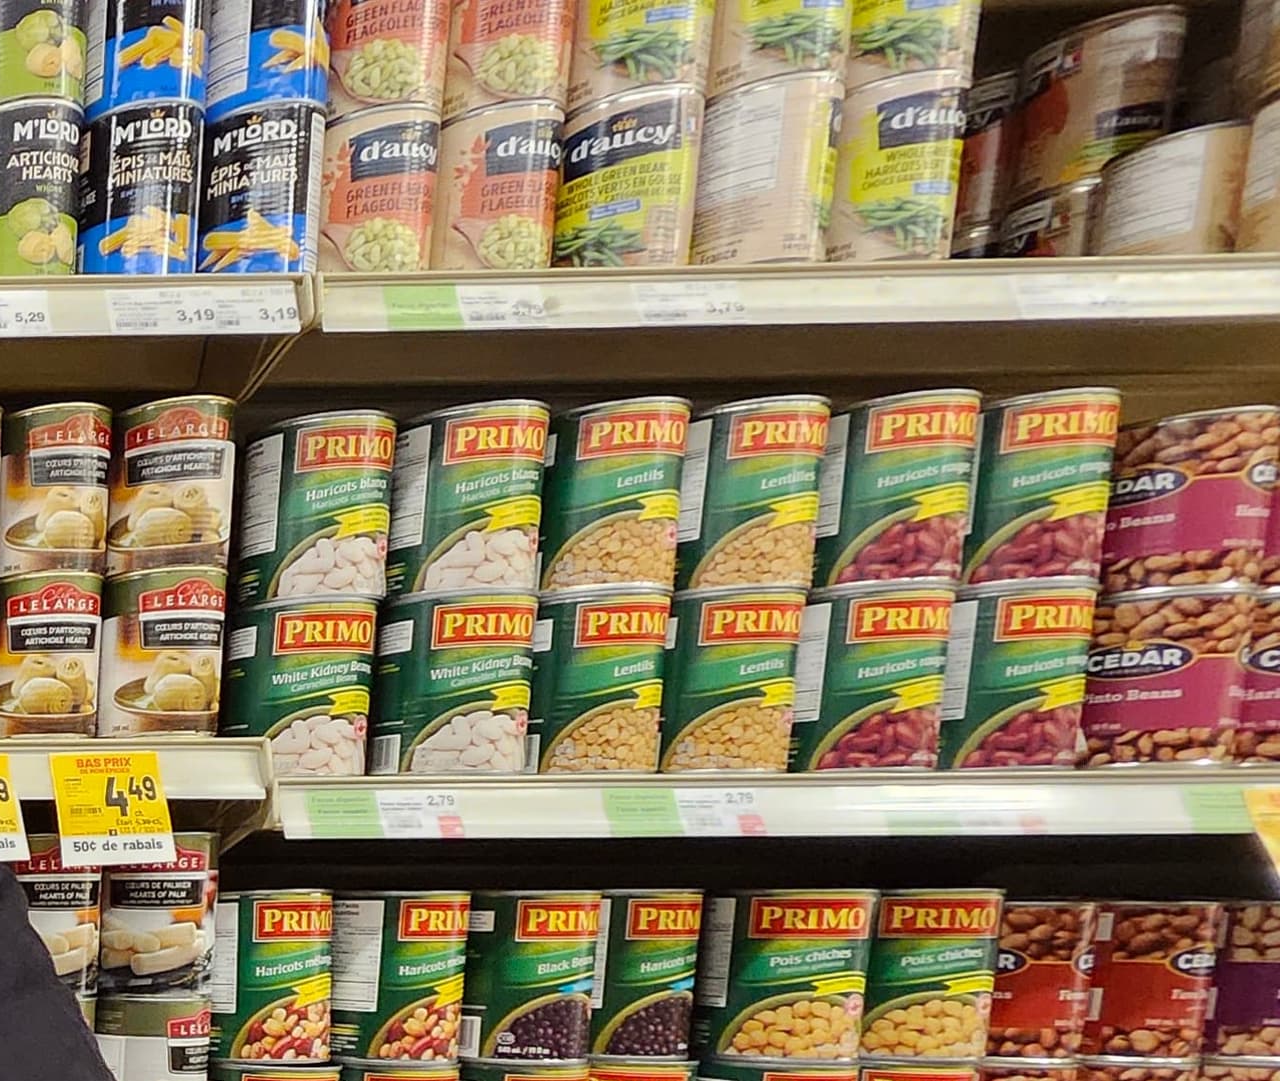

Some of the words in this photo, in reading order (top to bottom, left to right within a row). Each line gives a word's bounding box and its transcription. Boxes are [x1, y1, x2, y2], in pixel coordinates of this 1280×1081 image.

[13, 119, 79, 145] M'LORD
[571, 124, 678, 162] d'aucy
[22, 167, 74, 183] HEARTS
[15, 312, 45, 325] 5,29
[177, 309, 214, 323] 3,19
[588, 419, 683, 448] PRIMO
[304, 431, 393, 461] PRIMO
[617, 469, 665, 489] Lentils
[282, 619, 371, 645] PRIMO
[1087, 650, 1181, 672] CEDAR
[271, 670, 309, 686] White
[311, 665, 348, 680] Kidney
[76, 758, 100, 769] BAS
[104, 757, 132, 768] PRIX
[427, 796, 454, 808] 2,79
[73, 840, 97, 852] 50¢
[102, 839, 118, 851] de
[122, 838, 163, 851] rabais
[760, 905, 866, 929] PRIMO
[770, 954, 801, 967] Pois
[805, 948, 852, 963] chiches
